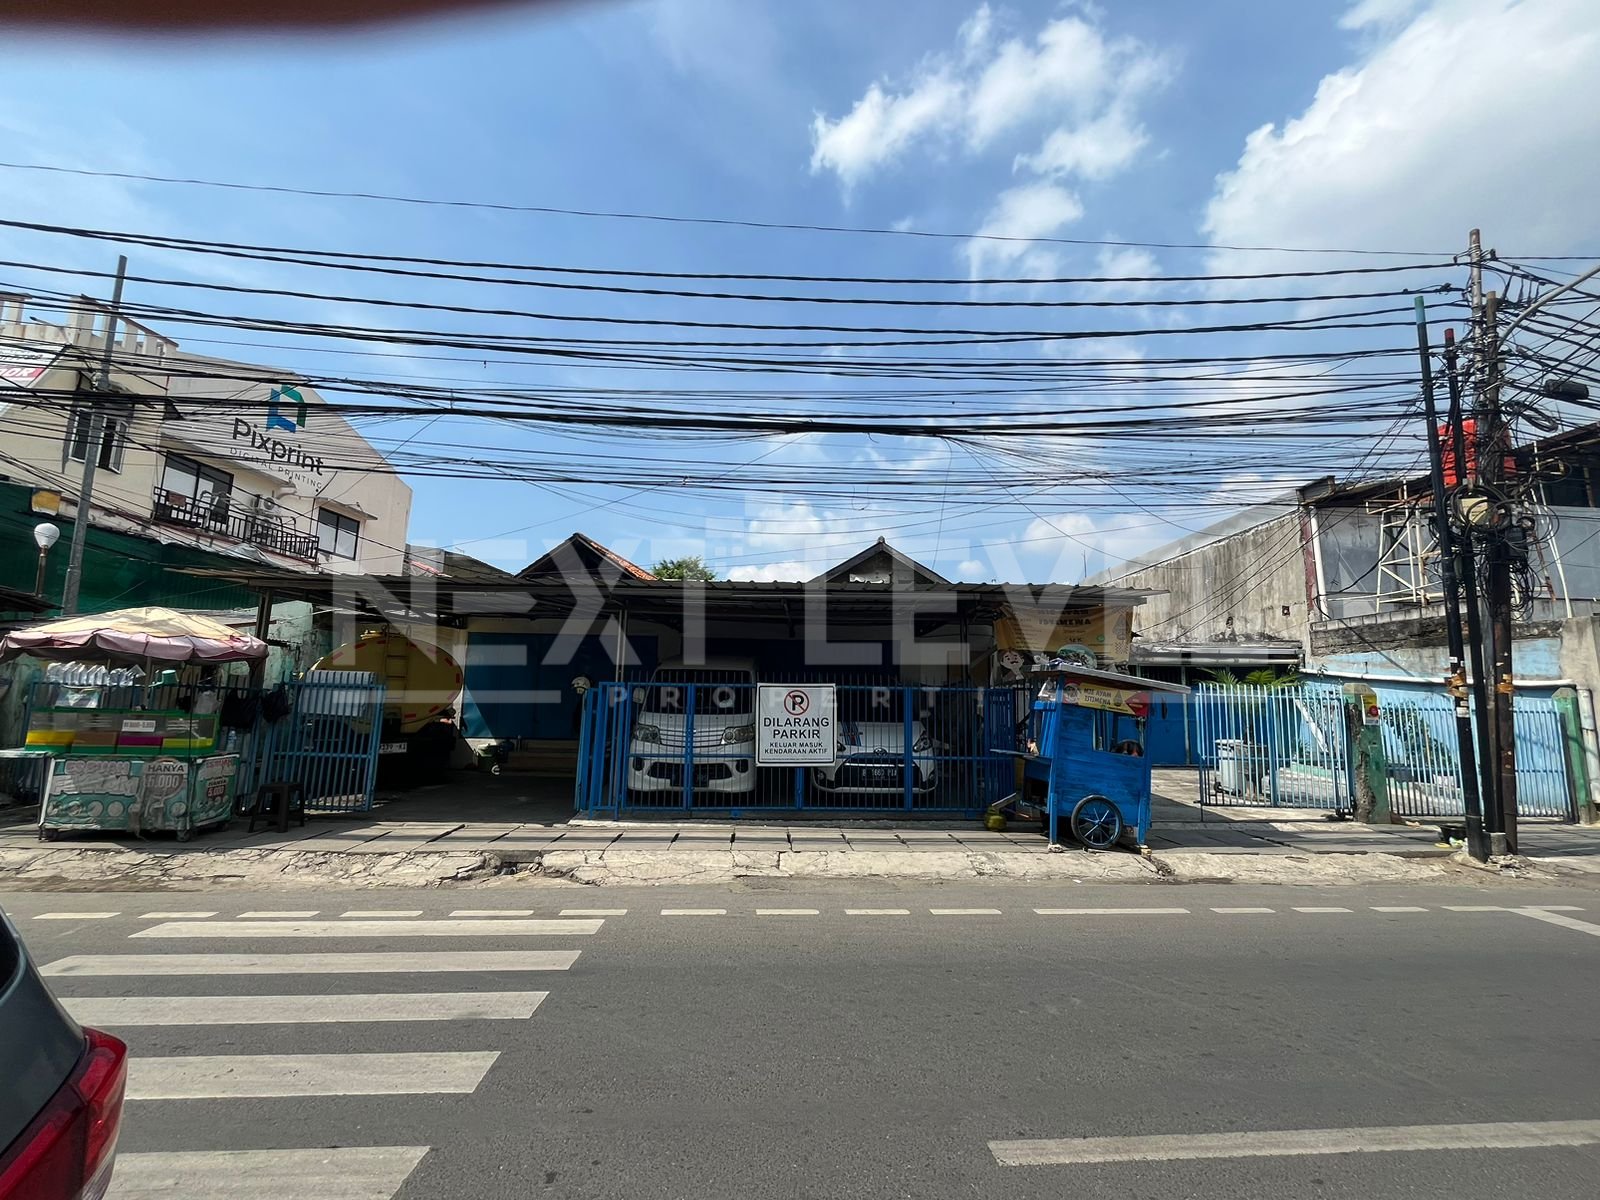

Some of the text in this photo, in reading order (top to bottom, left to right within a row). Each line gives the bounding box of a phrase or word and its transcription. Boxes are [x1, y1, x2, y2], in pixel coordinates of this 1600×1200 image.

[233, 417, 324, 476] Pixprint
[763, 717, 830, 728] DILARANG
[773, 729, 820, 739] PARKIR
[148, 764, 185, 773] HANYA
